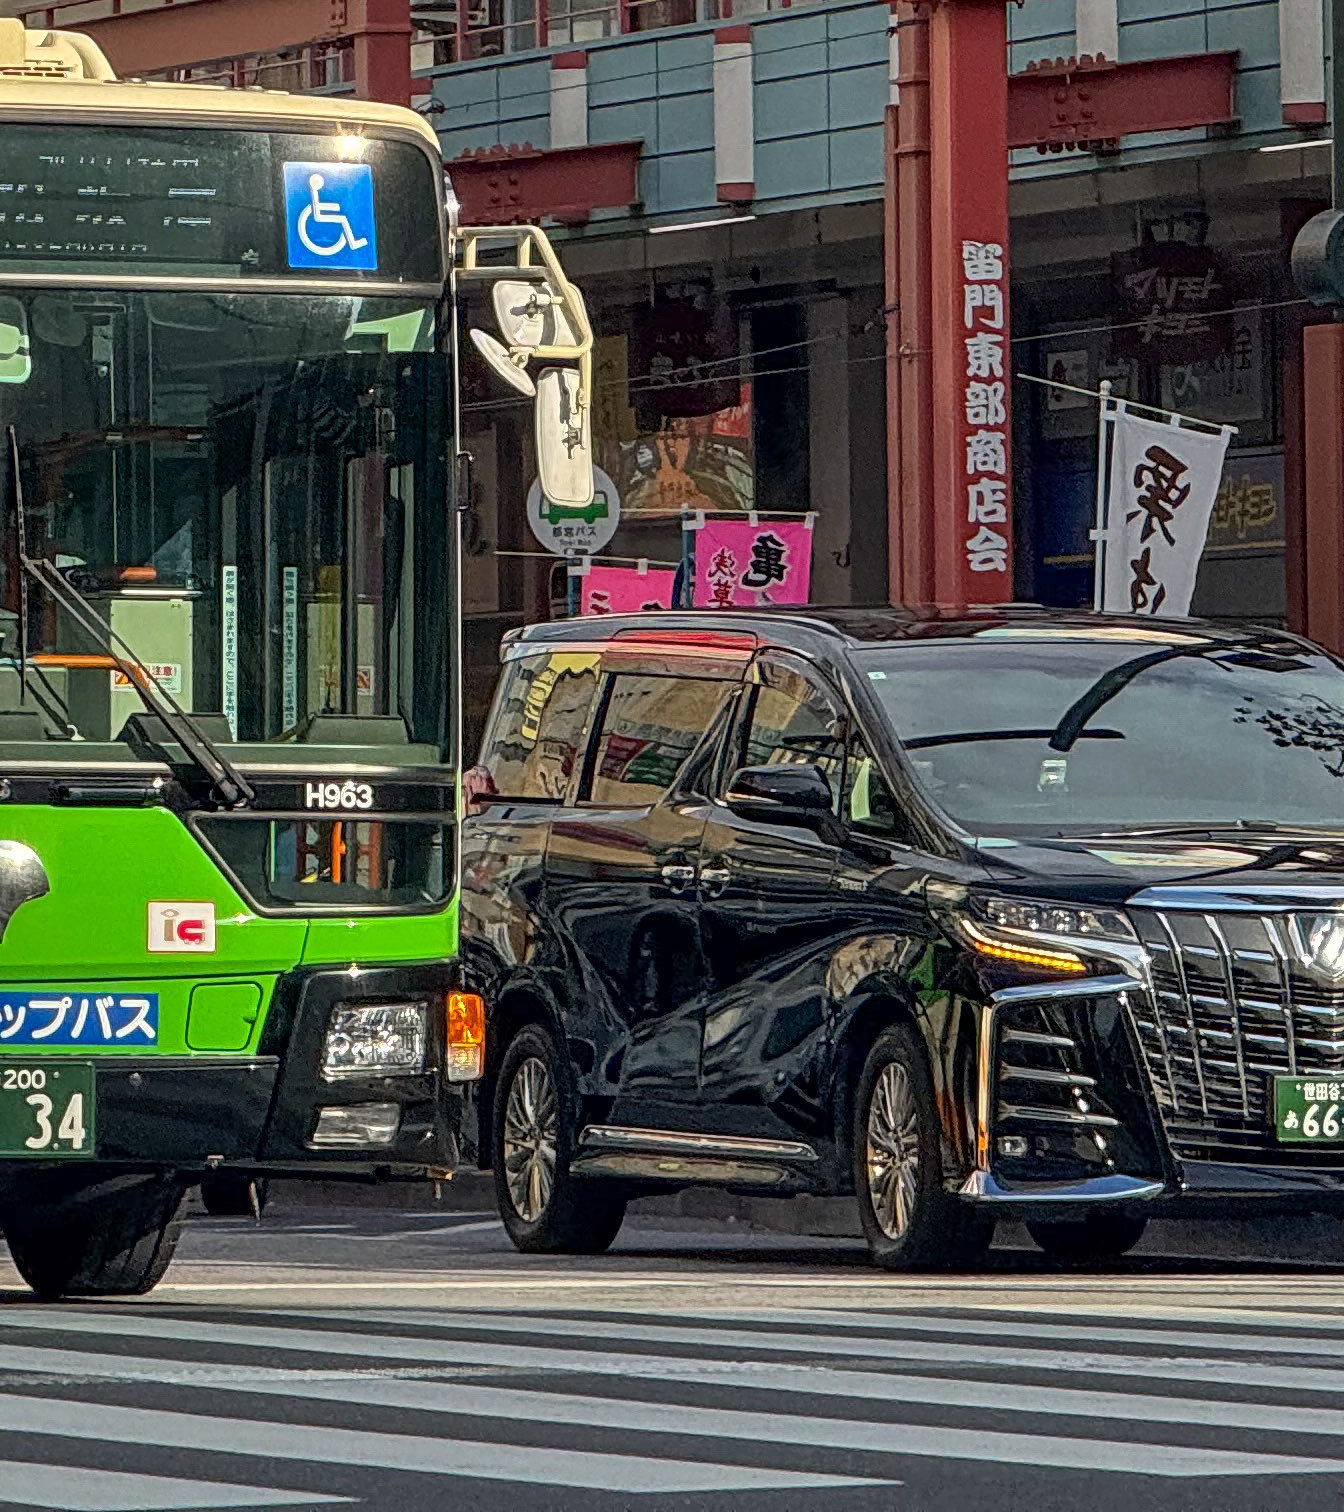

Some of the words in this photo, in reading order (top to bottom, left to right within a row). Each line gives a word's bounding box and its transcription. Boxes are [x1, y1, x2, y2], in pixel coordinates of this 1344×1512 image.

[962, 239, 1009, 573] 雷門東部商店会
[306, 782, 373, 809] H963
[1303, 1082, 1344, 1100] 世田谷
[1303, 1104, 1344, 1137] 66
